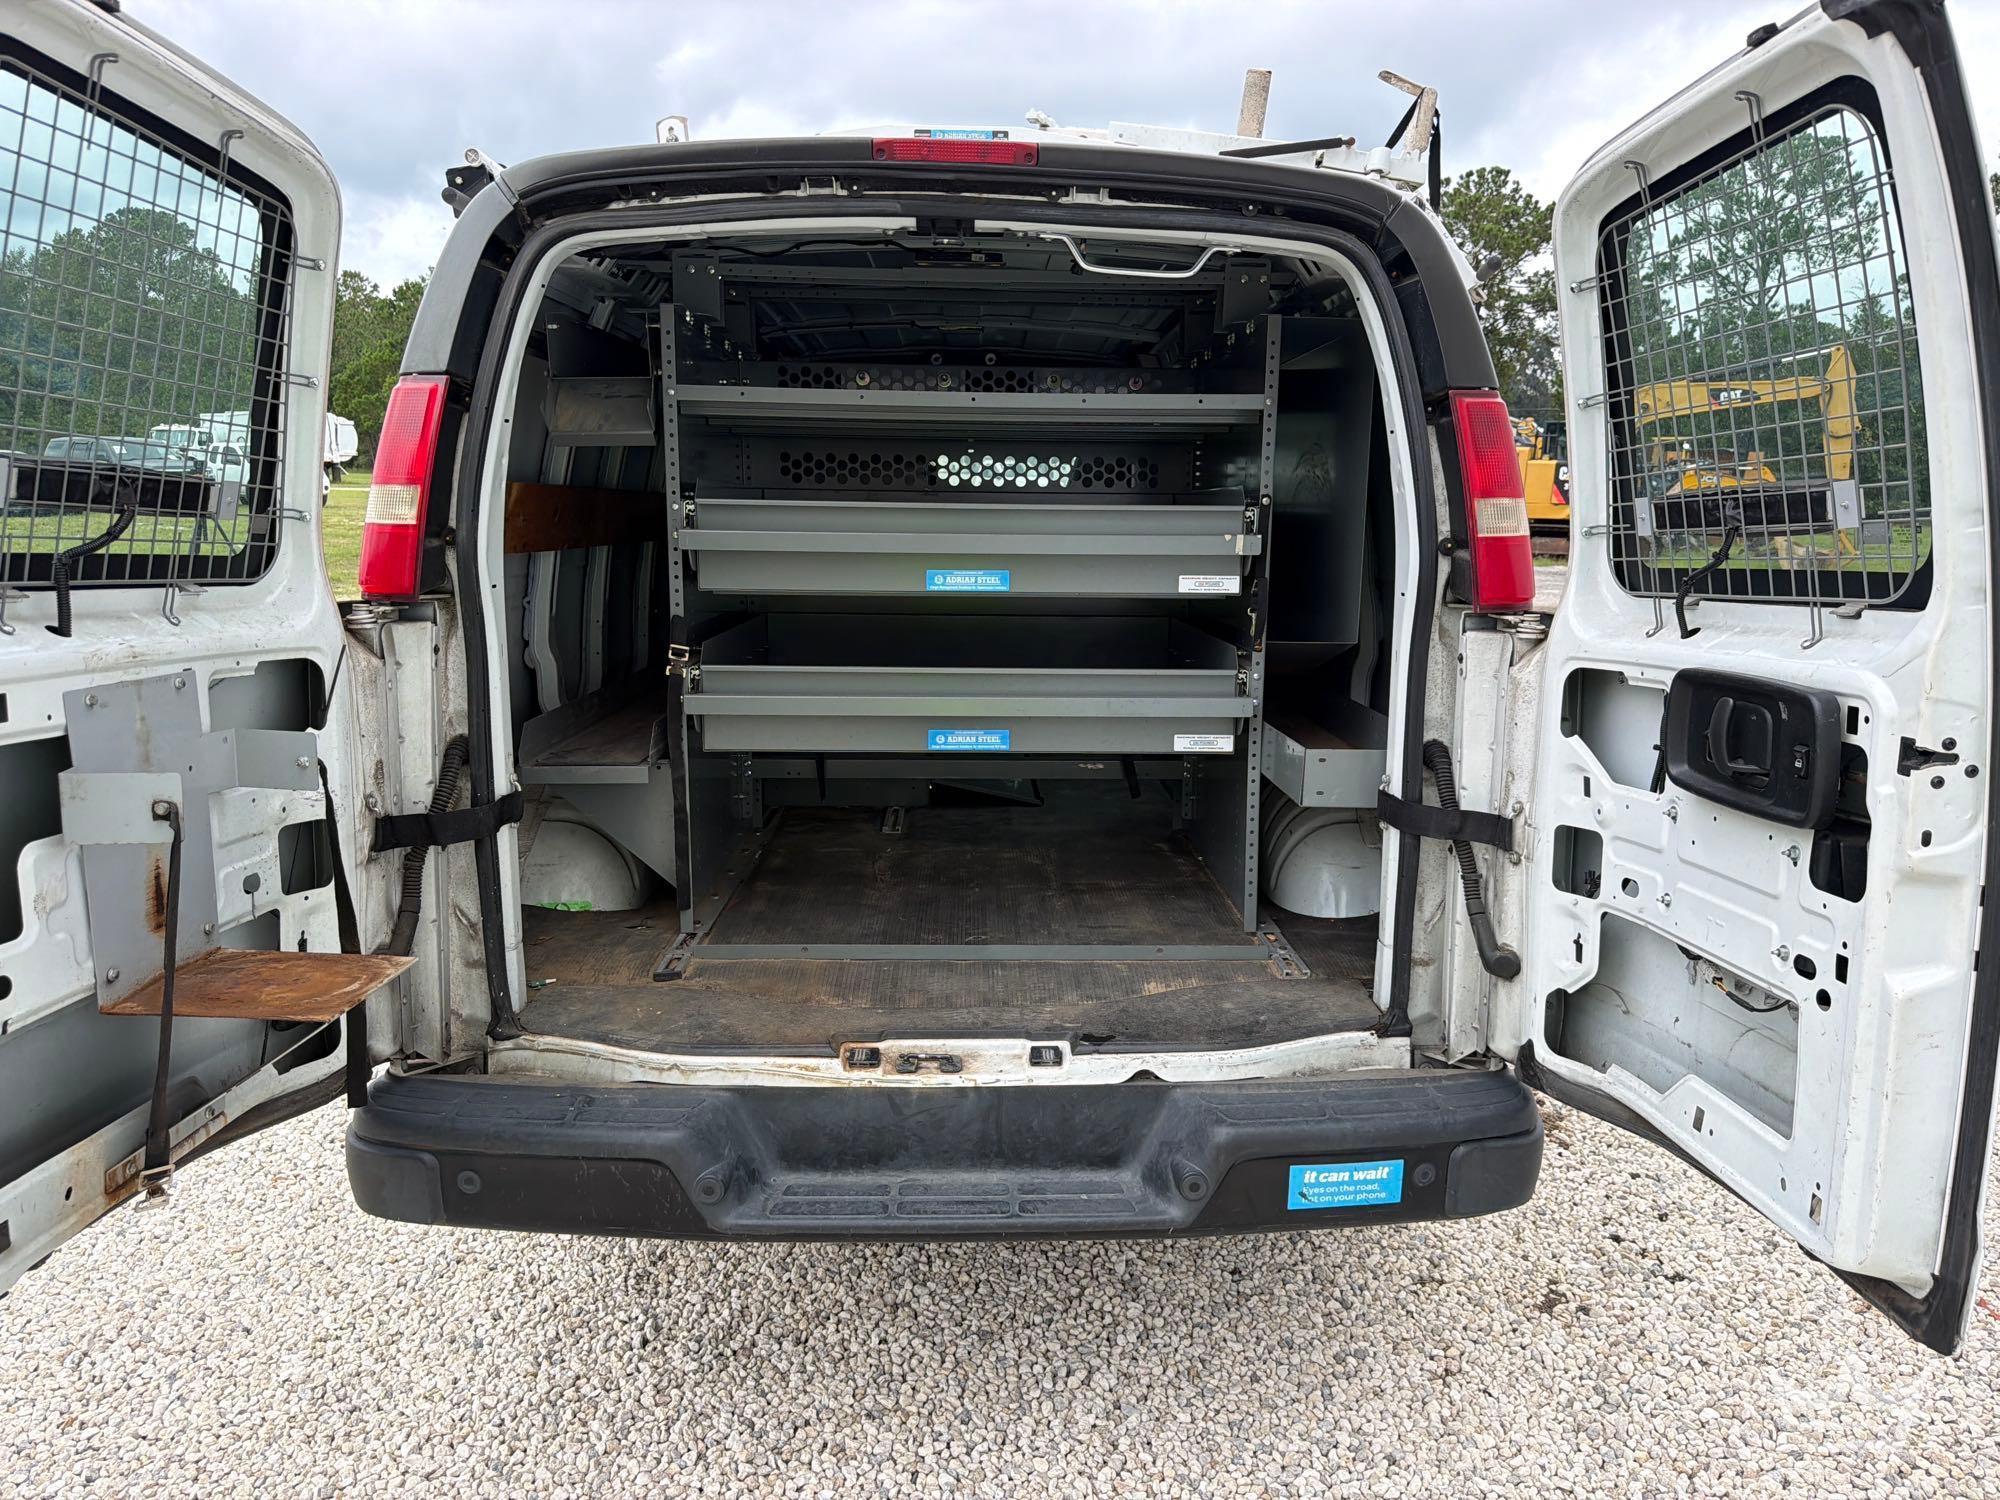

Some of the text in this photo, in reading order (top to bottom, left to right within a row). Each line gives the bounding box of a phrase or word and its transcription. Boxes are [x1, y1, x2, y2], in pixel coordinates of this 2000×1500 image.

[1719, 389, 1743, 405] CAT
[945, 575, 1001, 584] ADRIAN STEEL
[947, 735, 1001, 743] ADRIAN STEEL
[1303, 1166, 1390, 1183] it can wait
[1303, 1186, 1325, 1195] Eyes
[1339, 1184, 1355, 1192] the
[1356, 1183, 1380, 1191] road,
[1319, 1194, 1332, 1202] on
[1333, 1193, 1354, 1203] your
[1356, 1191, 1386, 1200] phone
